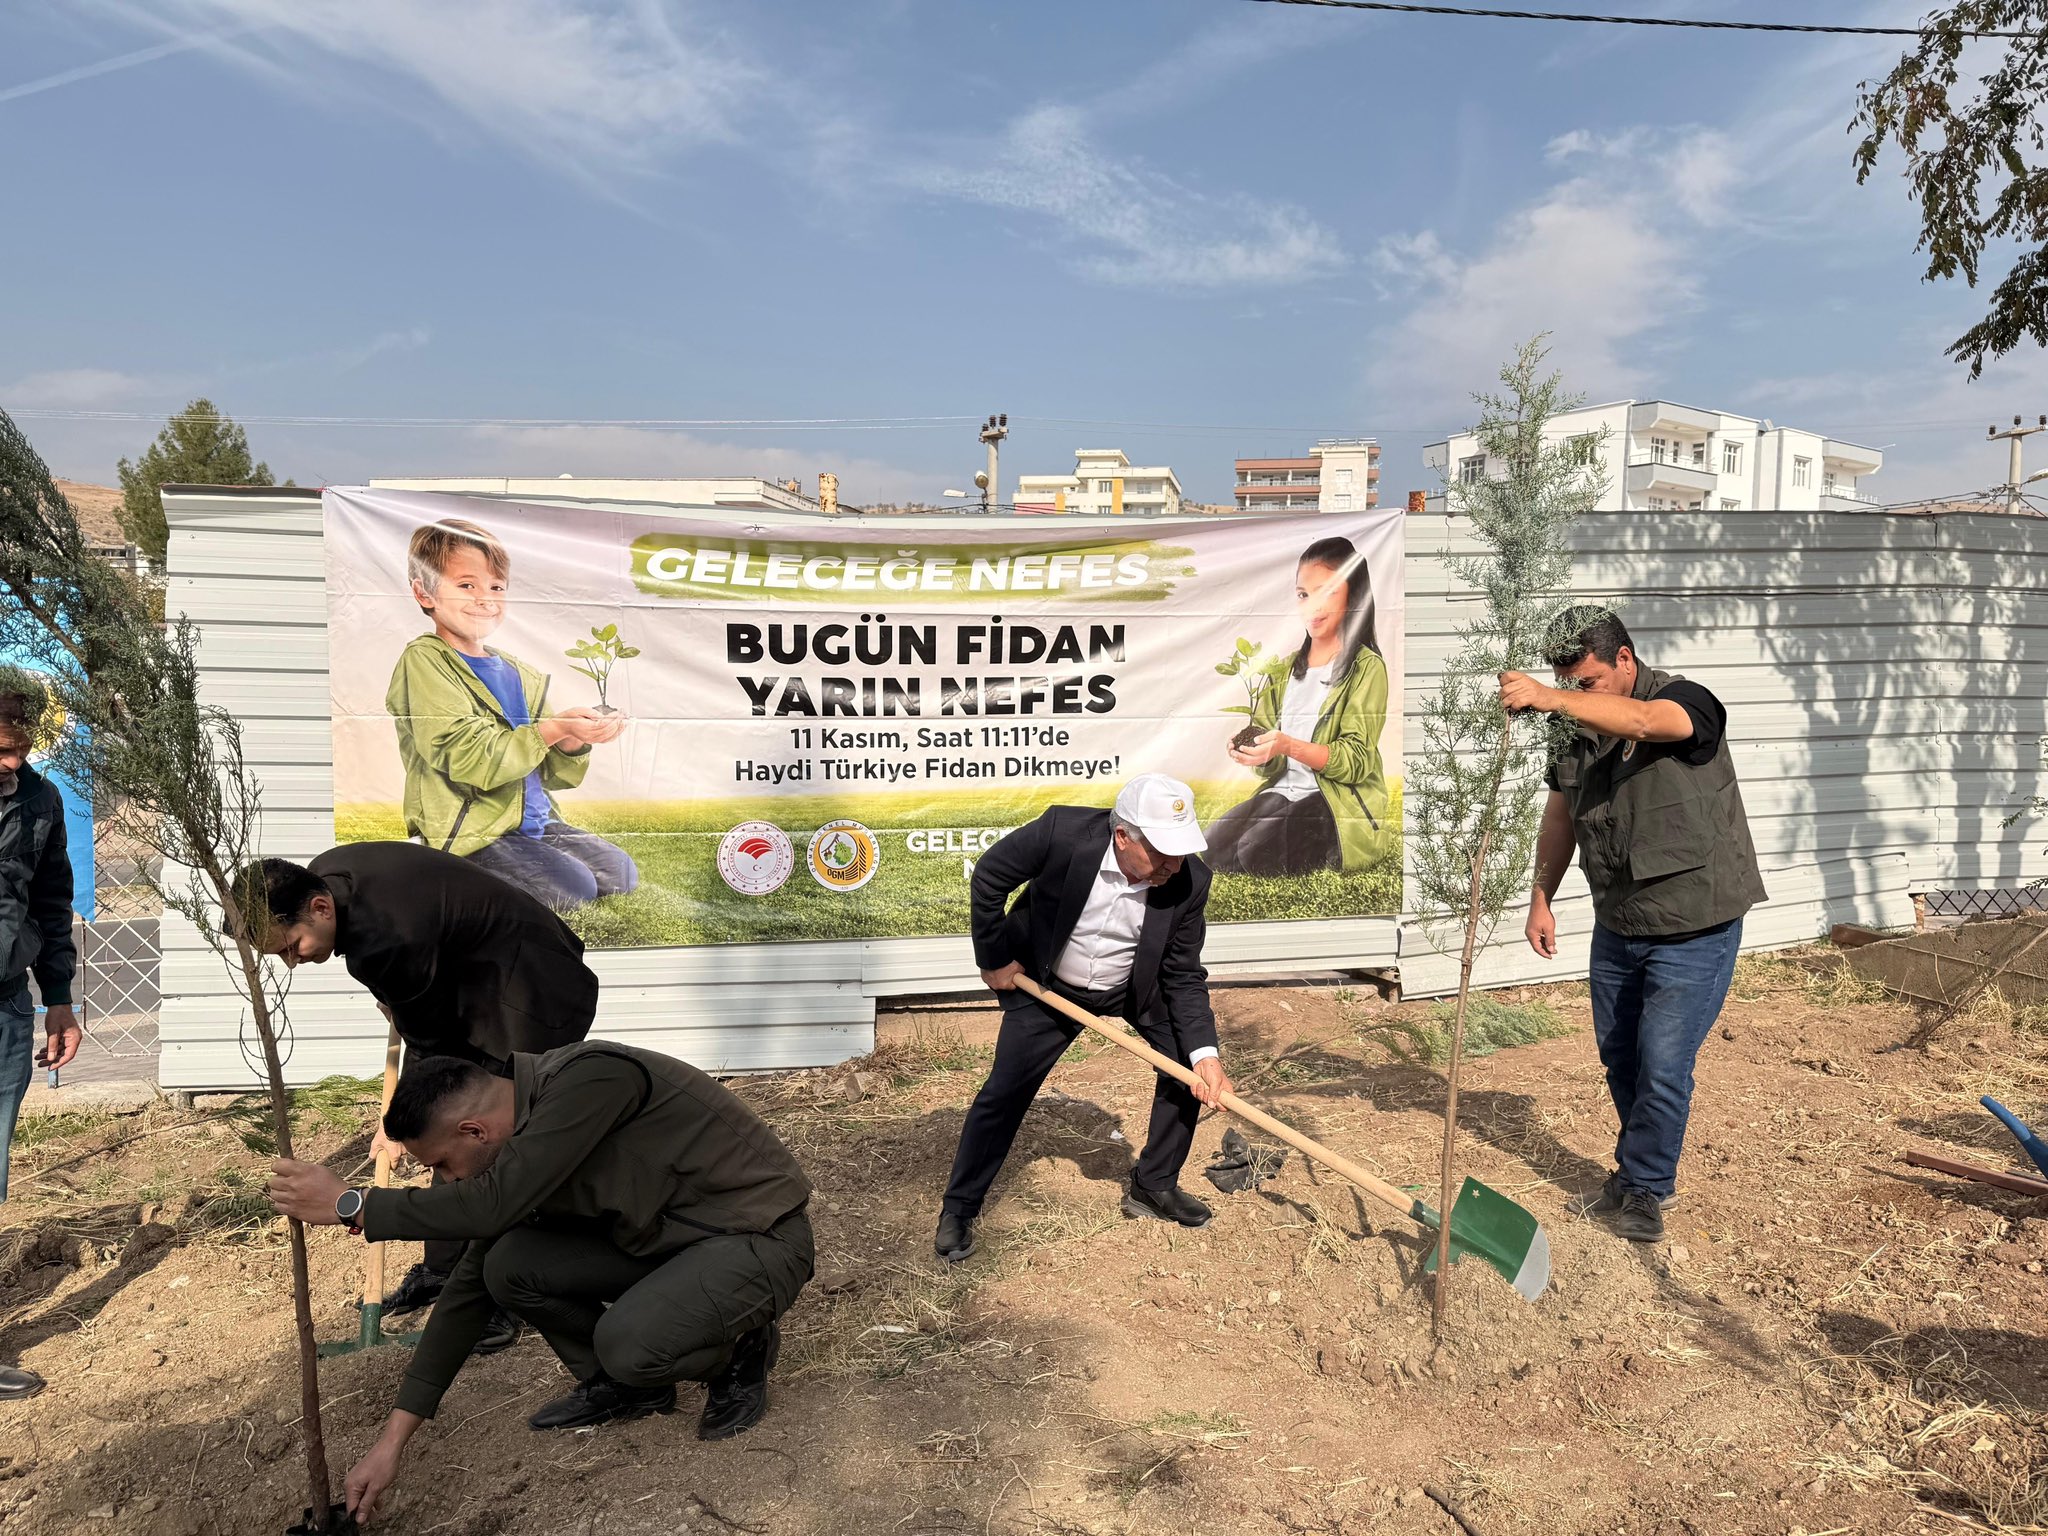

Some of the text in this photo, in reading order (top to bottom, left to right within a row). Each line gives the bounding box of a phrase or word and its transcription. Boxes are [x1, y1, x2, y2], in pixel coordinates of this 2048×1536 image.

[646, 549, 1149, 591] GELECEĞE NEFES
[727, 614, 1125, 665] BUGÜN FİDAN
[736, 675, 1116, 716] YARIN NEFES
[791, 728, 811, 748] 11
[822, 728, 908, 752] Kasım,
[917, 727, 973, 747] Saat
[735, 756, 1120, 784] Haydi Türkiye Fidan Dikmeye!
[827, 868, 845, 880] OGM
